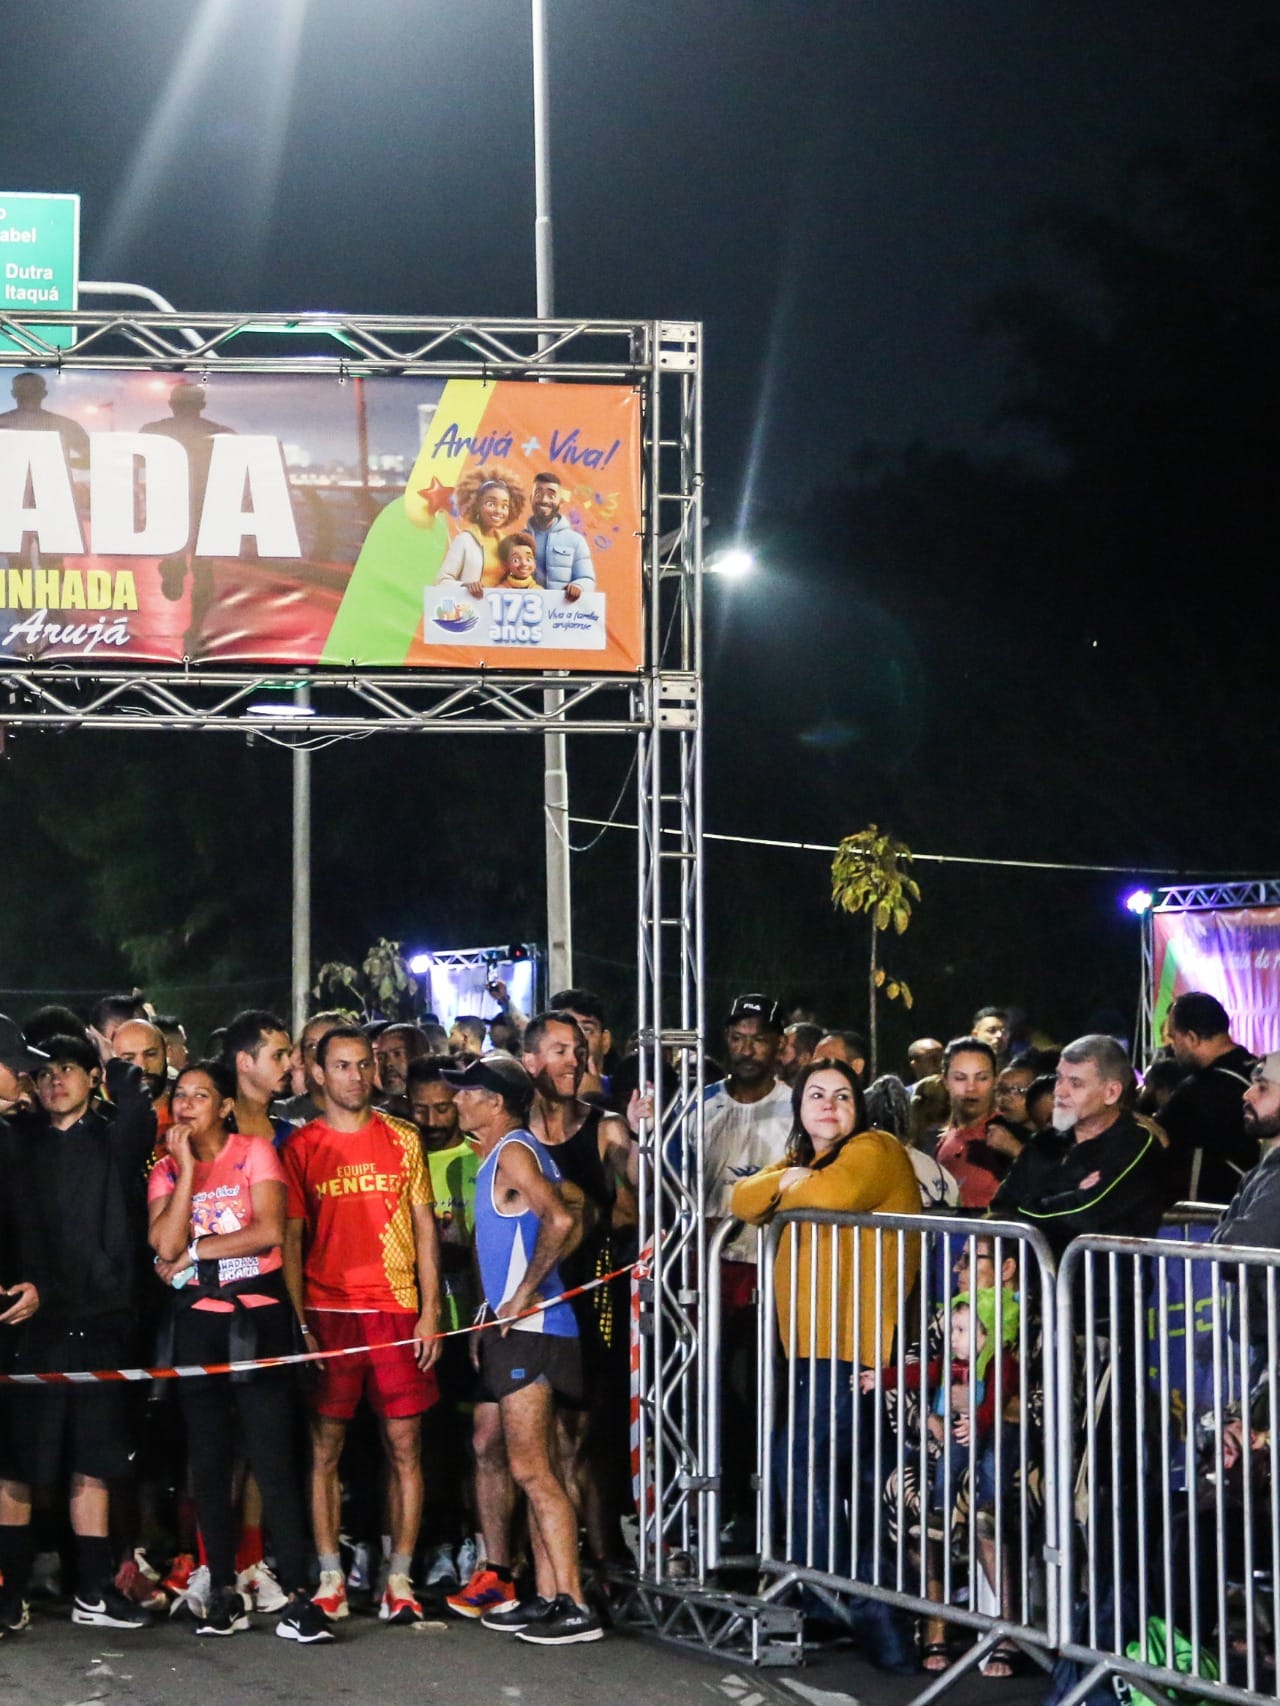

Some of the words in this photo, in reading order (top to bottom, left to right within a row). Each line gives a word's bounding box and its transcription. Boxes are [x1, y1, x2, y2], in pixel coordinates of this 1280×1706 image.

[5, 263, 53, 281] Dutra
[4, 284, 59, 305] Itaquá
[431, 422, 513, 466] Arujá
[521, 436, 542, 456] +
[548, 428, 621, 471] Viva!
[486, 593, 542, 625] 173
[1, 608, 130, 653] Arujá
[489, 625, 542, 644] anos
[336, 1163, 377, 1178] EQUIPE
